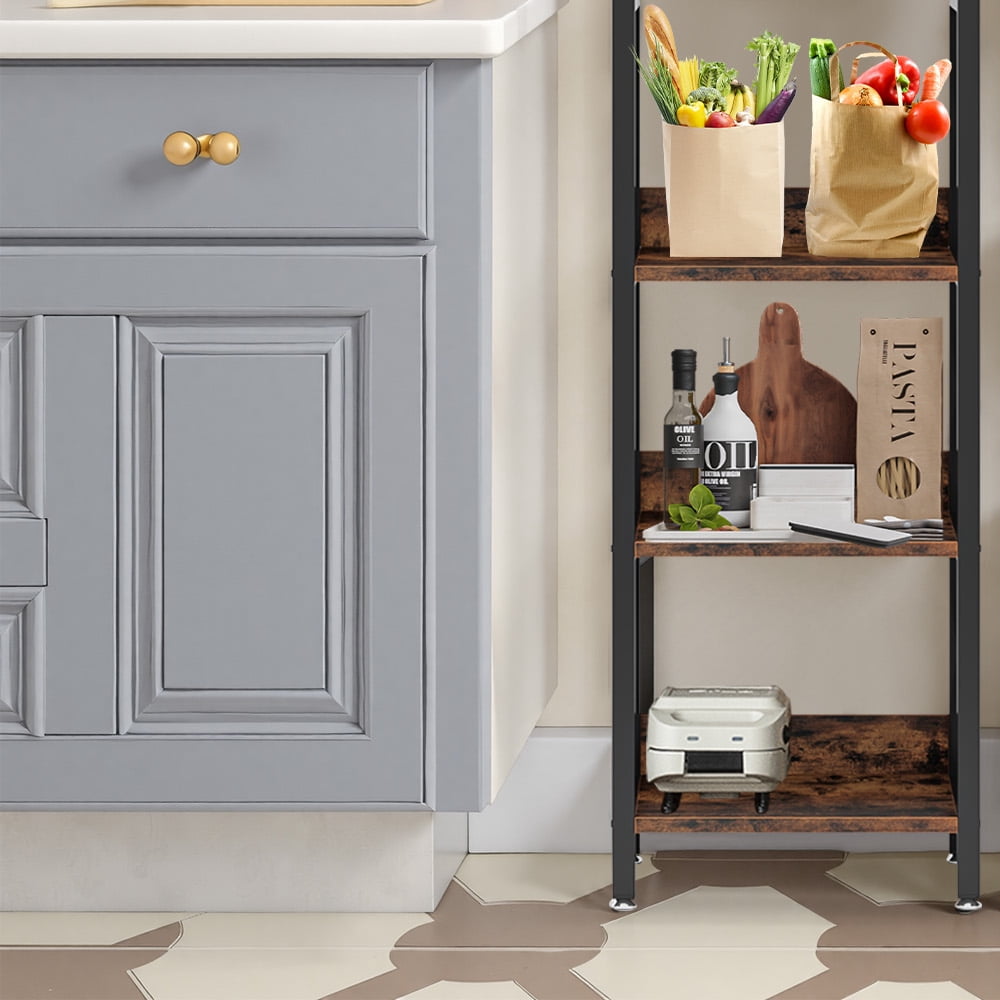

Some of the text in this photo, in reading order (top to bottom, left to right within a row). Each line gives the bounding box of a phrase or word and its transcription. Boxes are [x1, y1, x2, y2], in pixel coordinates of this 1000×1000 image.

[891, 343, 917, 443] PASTA
[674, 425, 696, 434] OLIVE
[676, 435, 694, 443] OIL
[704, 441, 758, 471] OIL
